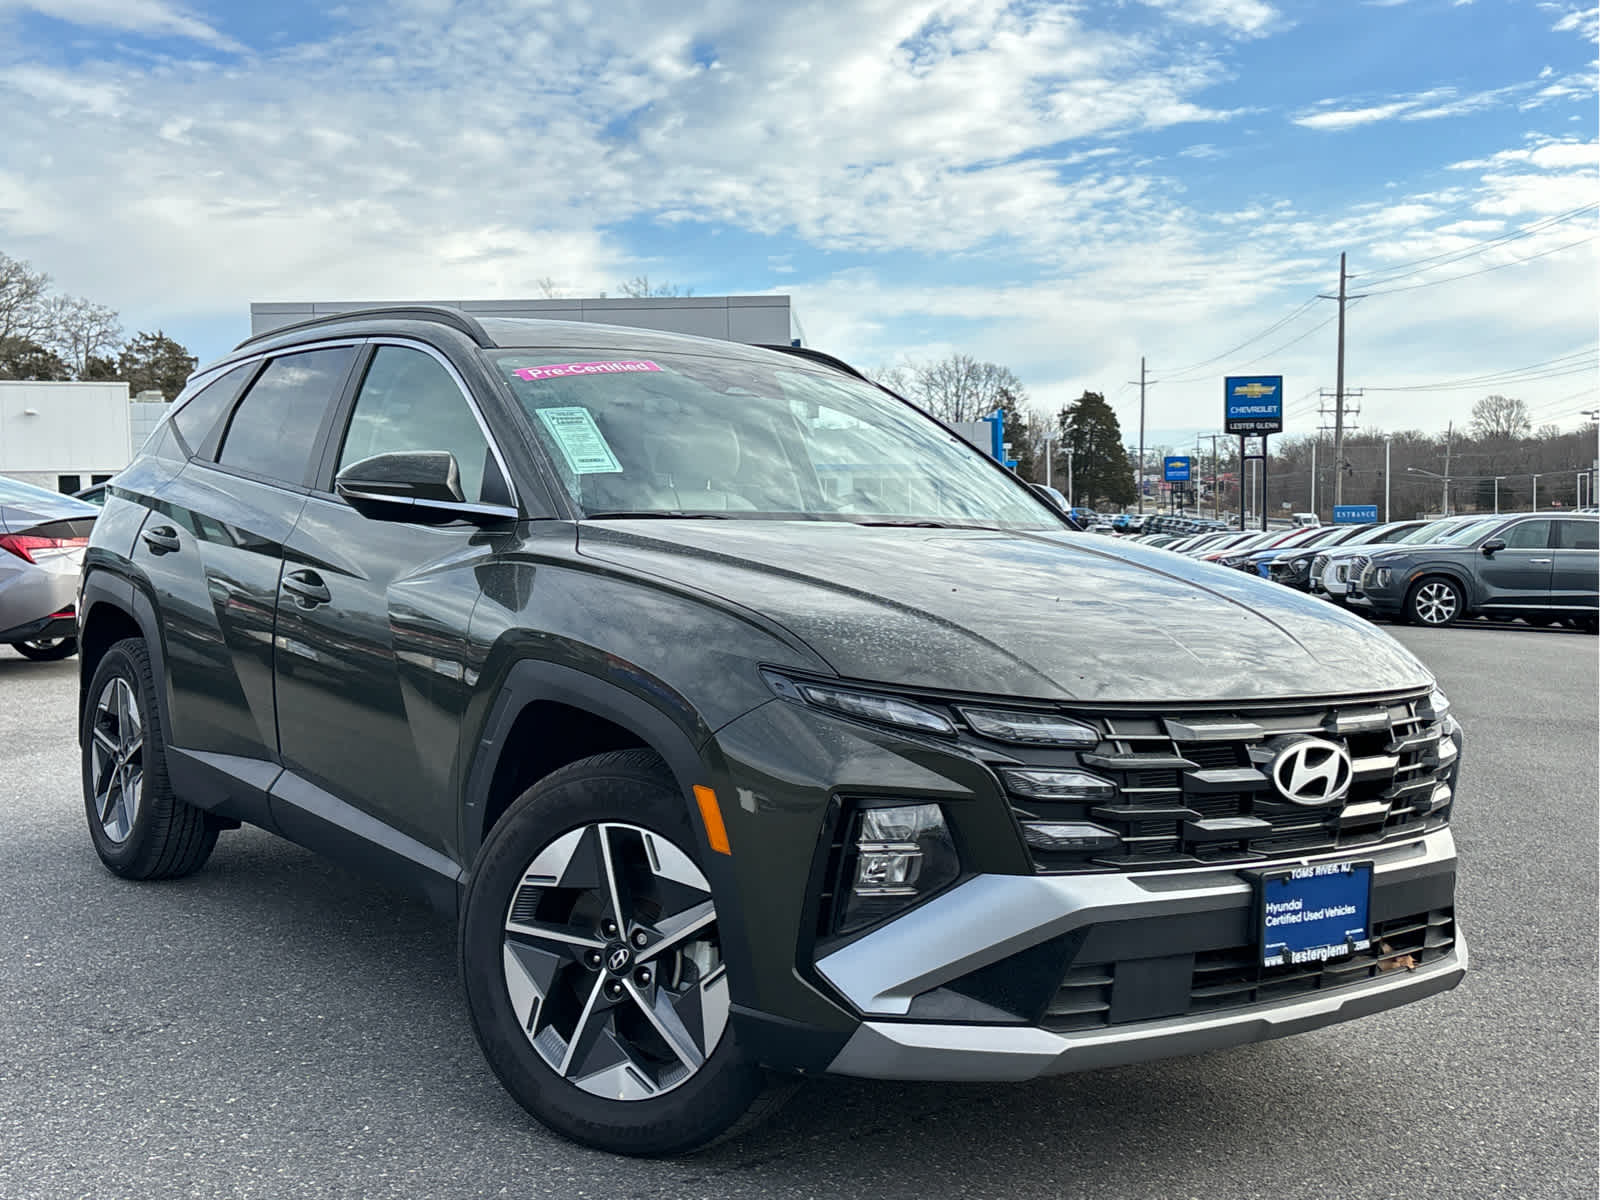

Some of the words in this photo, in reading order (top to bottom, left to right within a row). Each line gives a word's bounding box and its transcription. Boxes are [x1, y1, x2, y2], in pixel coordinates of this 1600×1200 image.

[528, 361, 649, 378] Pre-Certified
[1230, 405, 1278, 414] CHEVROLET
[1230, 422, 1255, 430] LESTER
[1336, 511, 1376, 519] ENTRANCE
[1291, 867, 1314, 879] TOMS
[1340, 862, 1351, 872] NJ
[1265, 899, 1303, 915] Hyundai
[1265, 912, 1302, 926] Certified
[1303, 908, 1324, 921] Used
[1324, 905, 1356, 917] Vehicles
[1291, 944, 1348, 963] lesterglenn
